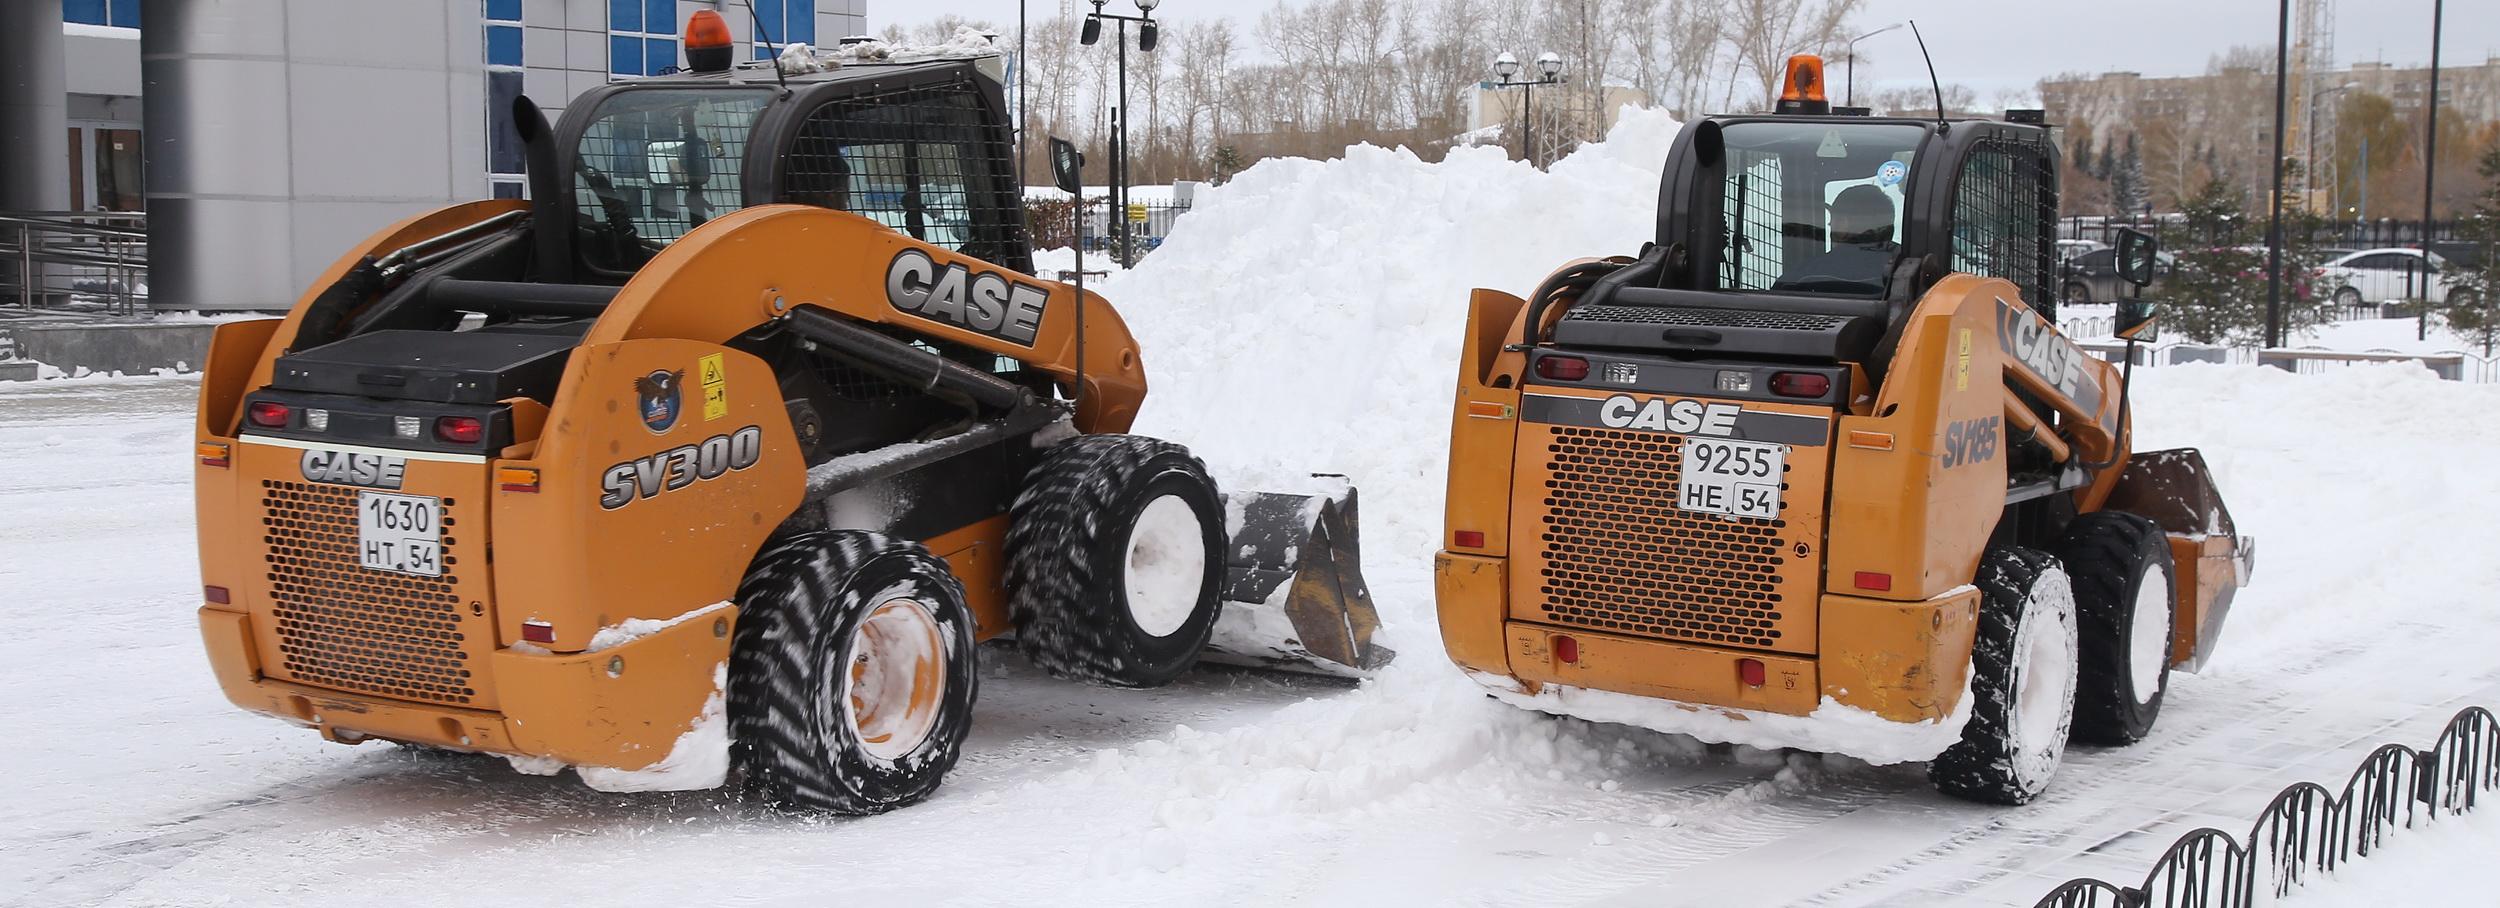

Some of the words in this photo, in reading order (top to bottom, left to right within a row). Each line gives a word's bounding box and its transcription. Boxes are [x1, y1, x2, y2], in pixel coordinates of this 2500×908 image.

[886, 249, 1048, 343] CASE
[2015, 309, 2083, 398] CASE
[1600, 394, 1741, 436] CASE
[1694, 443, 1771, 478] 9255
[1943, 416, 1998, 469] SV185
[301, 449, 406, 488] CASE
[600, 426, 764, 510] SV300
[370, 498, 429, 532] 1630
[1740, 489, 1770, 514] 54
[410, 545, 433, 571] 54
